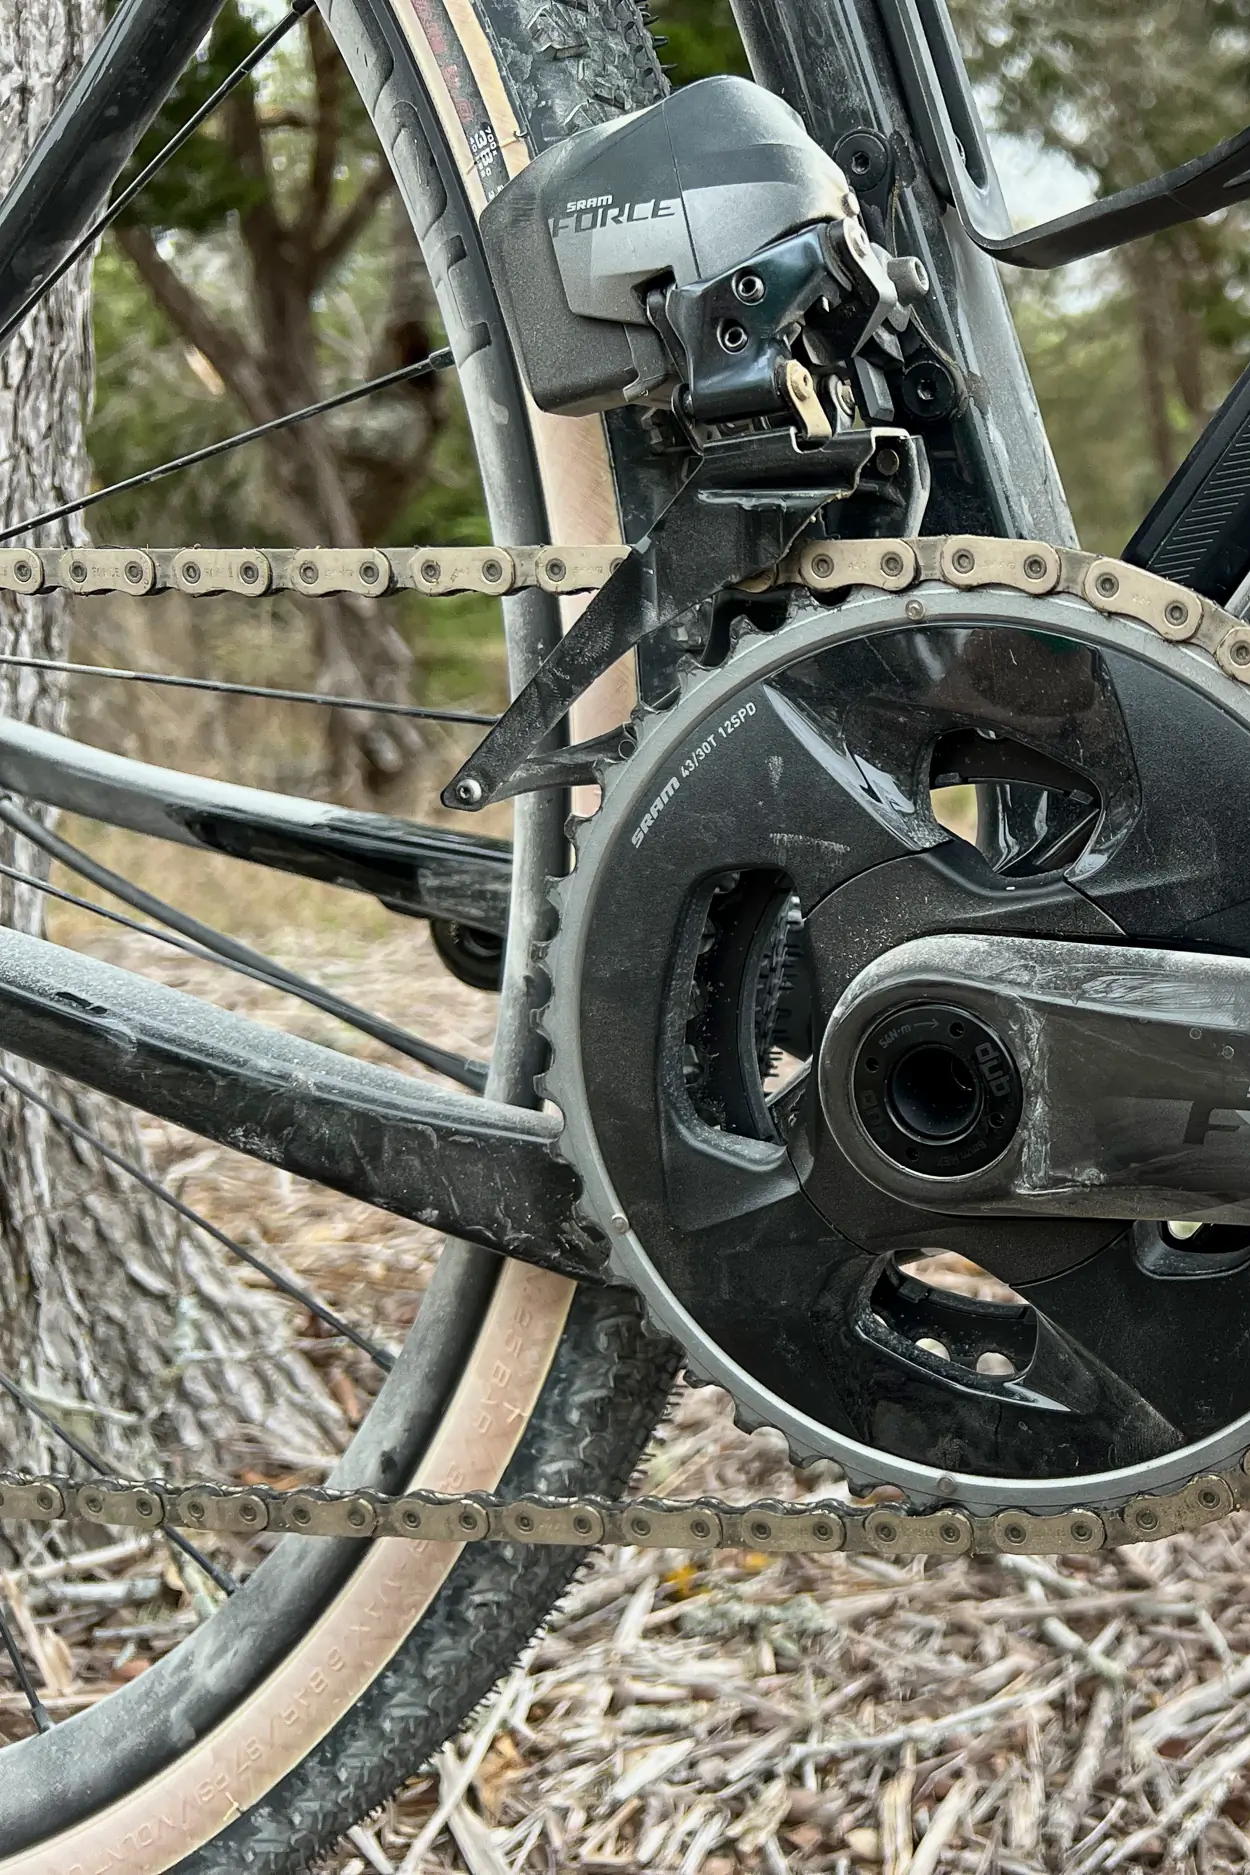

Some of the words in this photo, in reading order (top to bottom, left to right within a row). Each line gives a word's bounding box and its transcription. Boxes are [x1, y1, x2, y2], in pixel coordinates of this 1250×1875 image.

[550, 199, 681, 238] FORCE
[566, 194, 613, 213] SRAM
[631, 776, 681, 849] SRAM
[679, 734, 718, 778] 43/30T
[717, 702, 757, 738] 12SPD
